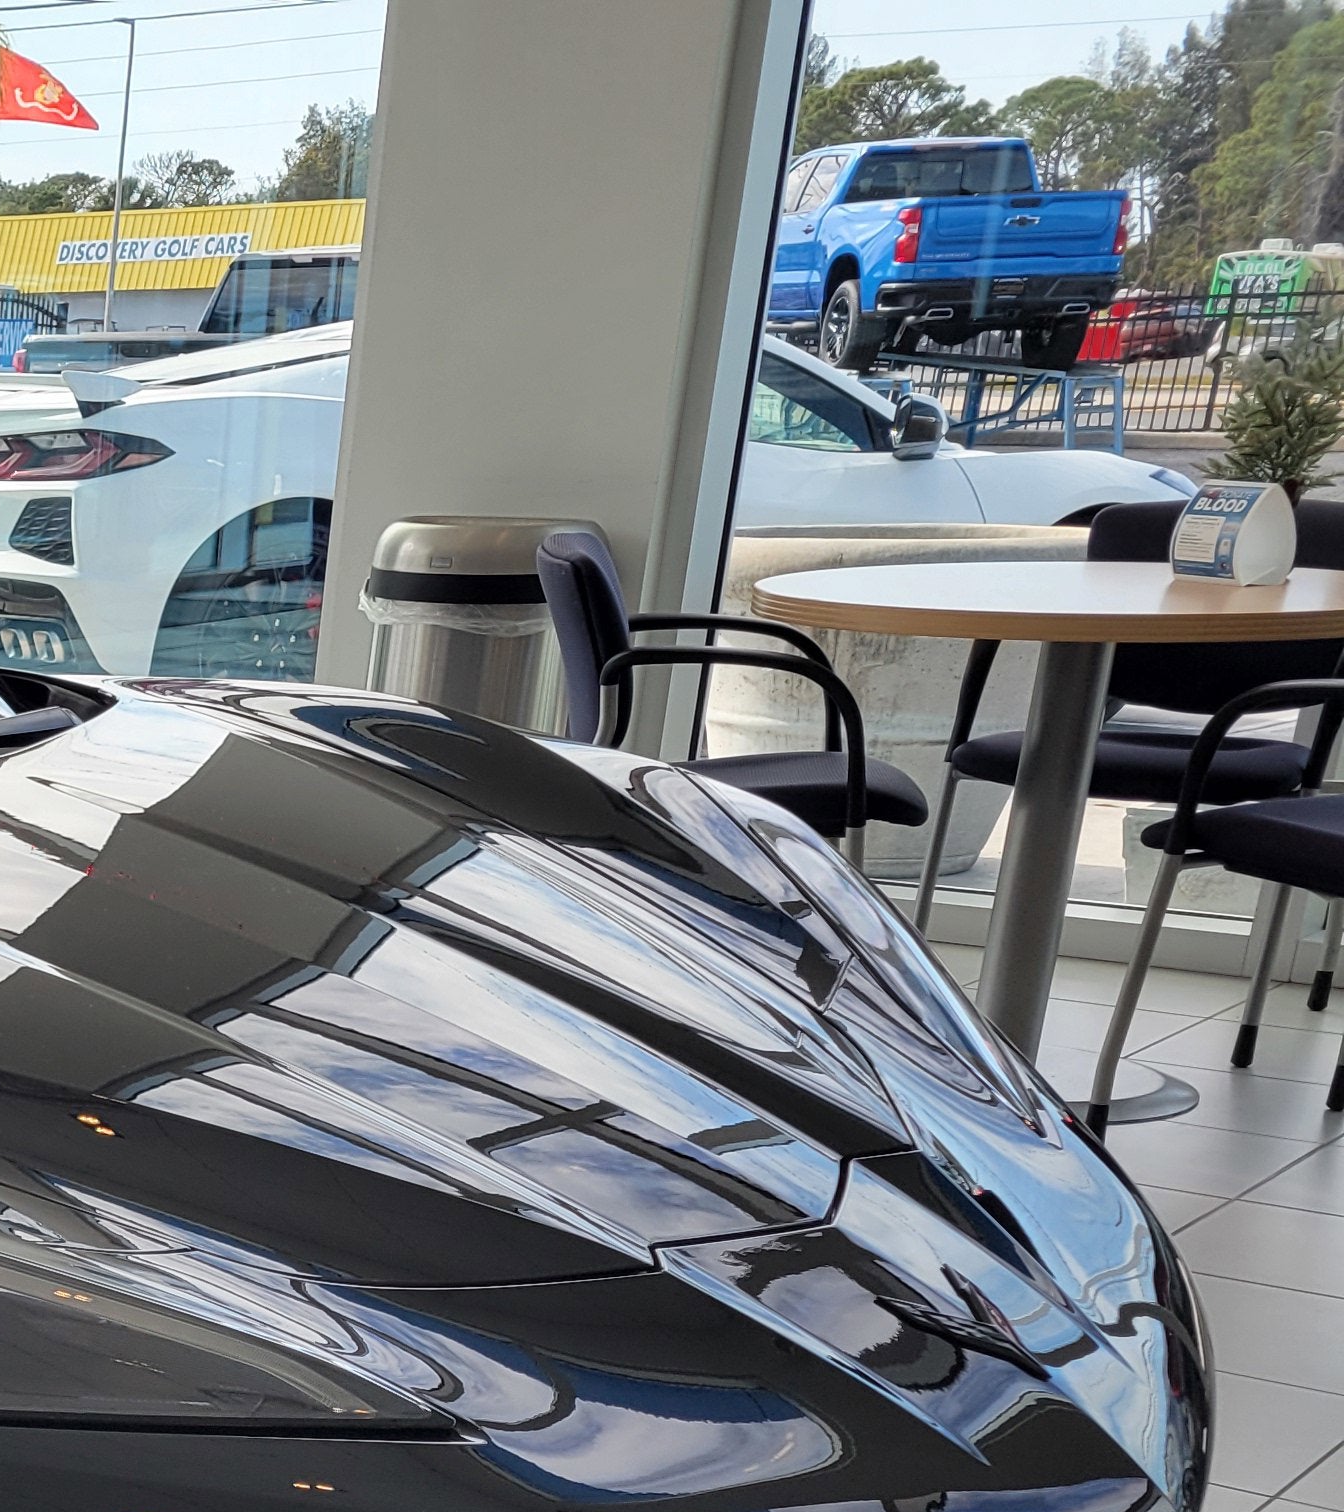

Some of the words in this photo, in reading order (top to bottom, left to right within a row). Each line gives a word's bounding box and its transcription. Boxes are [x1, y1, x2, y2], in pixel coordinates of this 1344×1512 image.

[154, 238, 200, 258] GOLF
[204, 235, 249, 255] CARS
[1193, 496, 1249, 512] BLOOD
